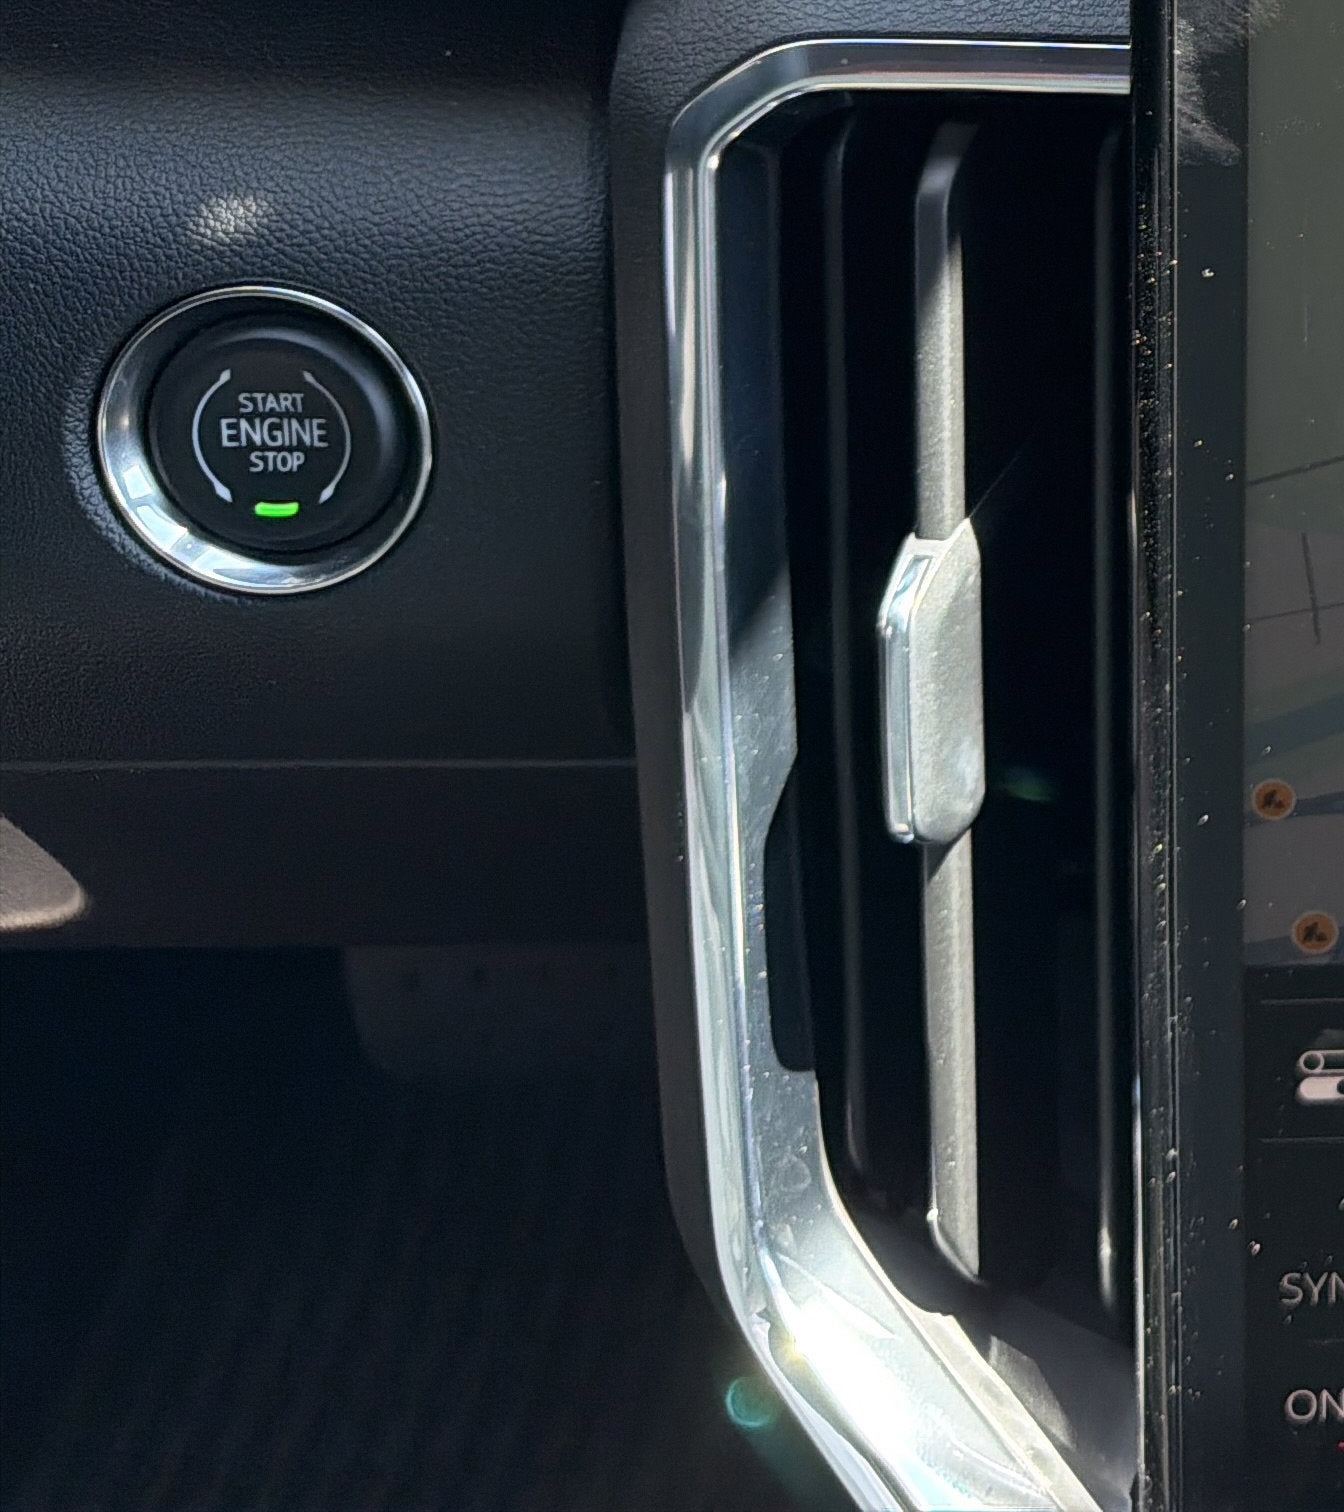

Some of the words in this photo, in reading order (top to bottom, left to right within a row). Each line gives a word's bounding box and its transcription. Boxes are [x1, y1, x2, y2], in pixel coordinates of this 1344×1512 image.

[238, 392, 304, 414] START
[219, 417, 330, 449] ENGINE
[249, 451, 306, 473] STOP
